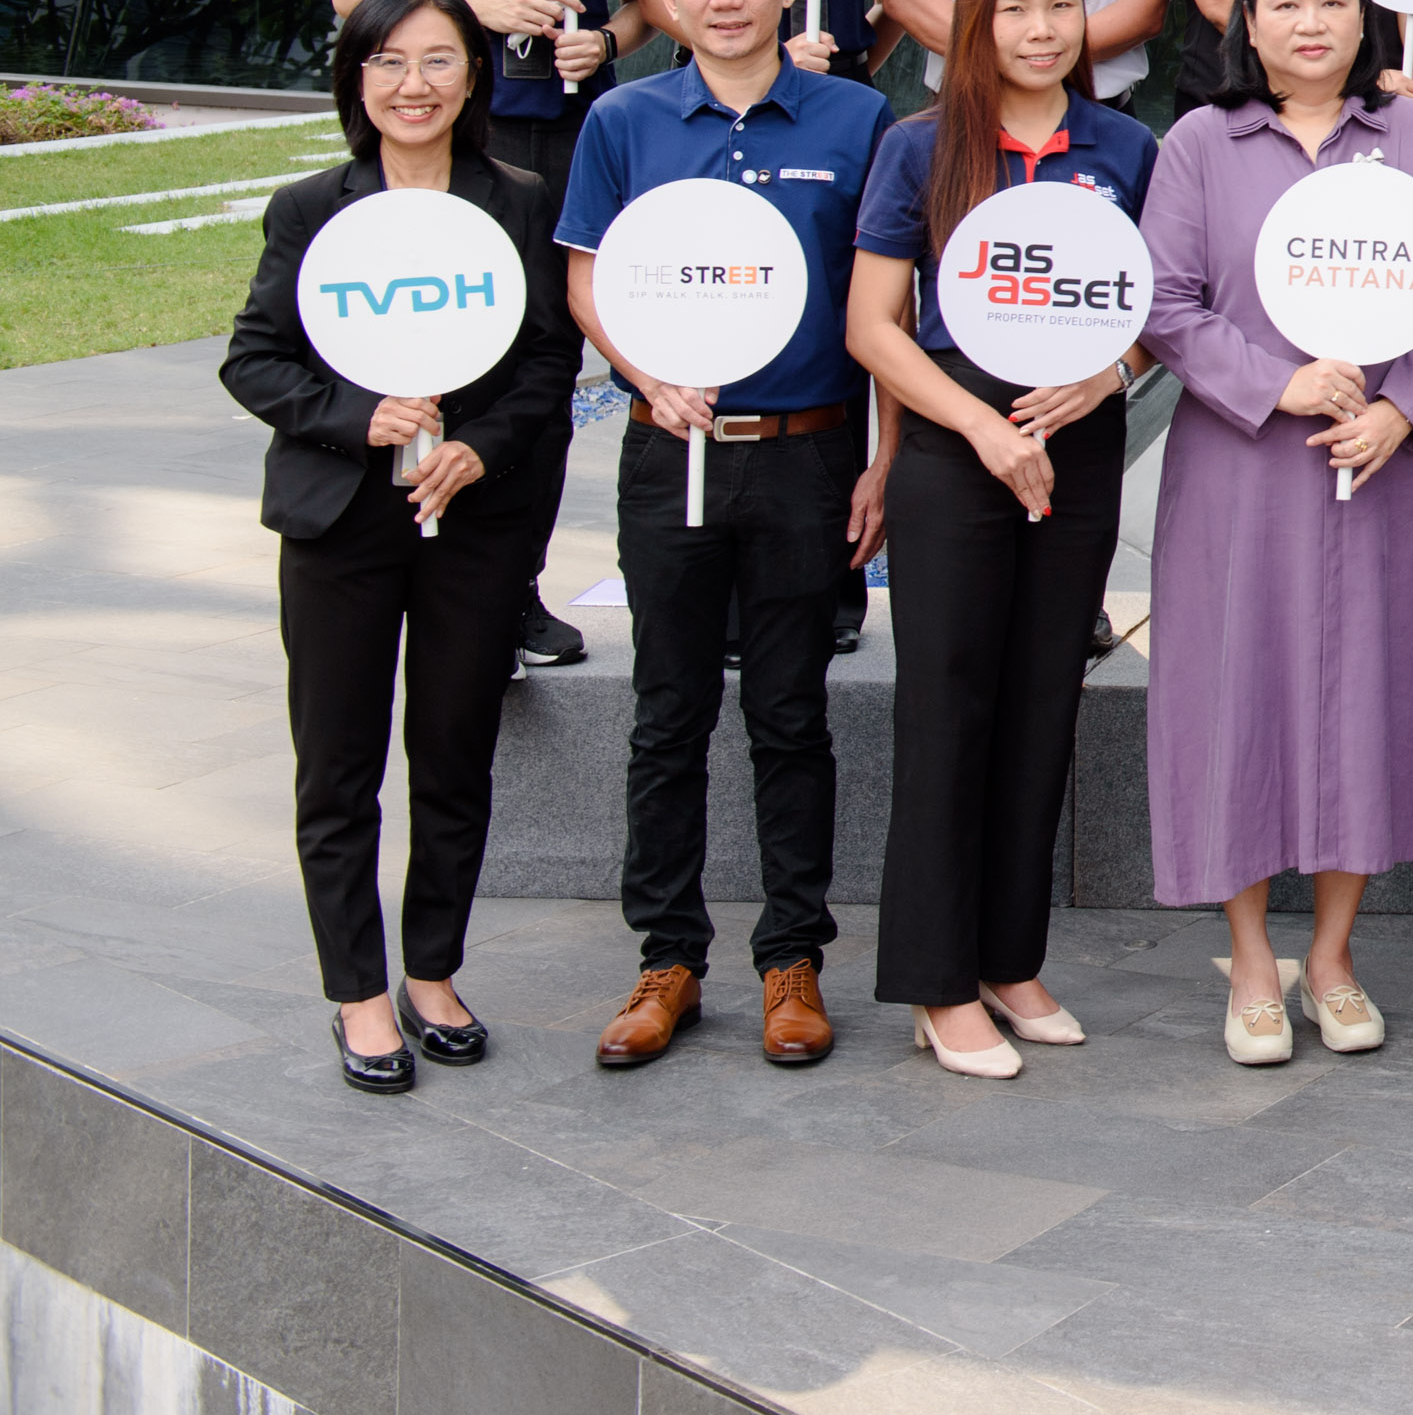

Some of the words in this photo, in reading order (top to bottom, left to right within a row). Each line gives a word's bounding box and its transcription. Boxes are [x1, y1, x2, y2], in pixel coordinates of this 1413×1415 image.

[628, 265, 673, 285] THE
[680, 265, 774, 284] STREET
[958, 240, 1053, 279] Jas
[319, 271, 496, 318] TVDH
[987, 271, 1135, 311] asset
[987, 312, 1046, 325] PROPERTY
[1049, 315, 1133, 329] DEVELOPMENT
